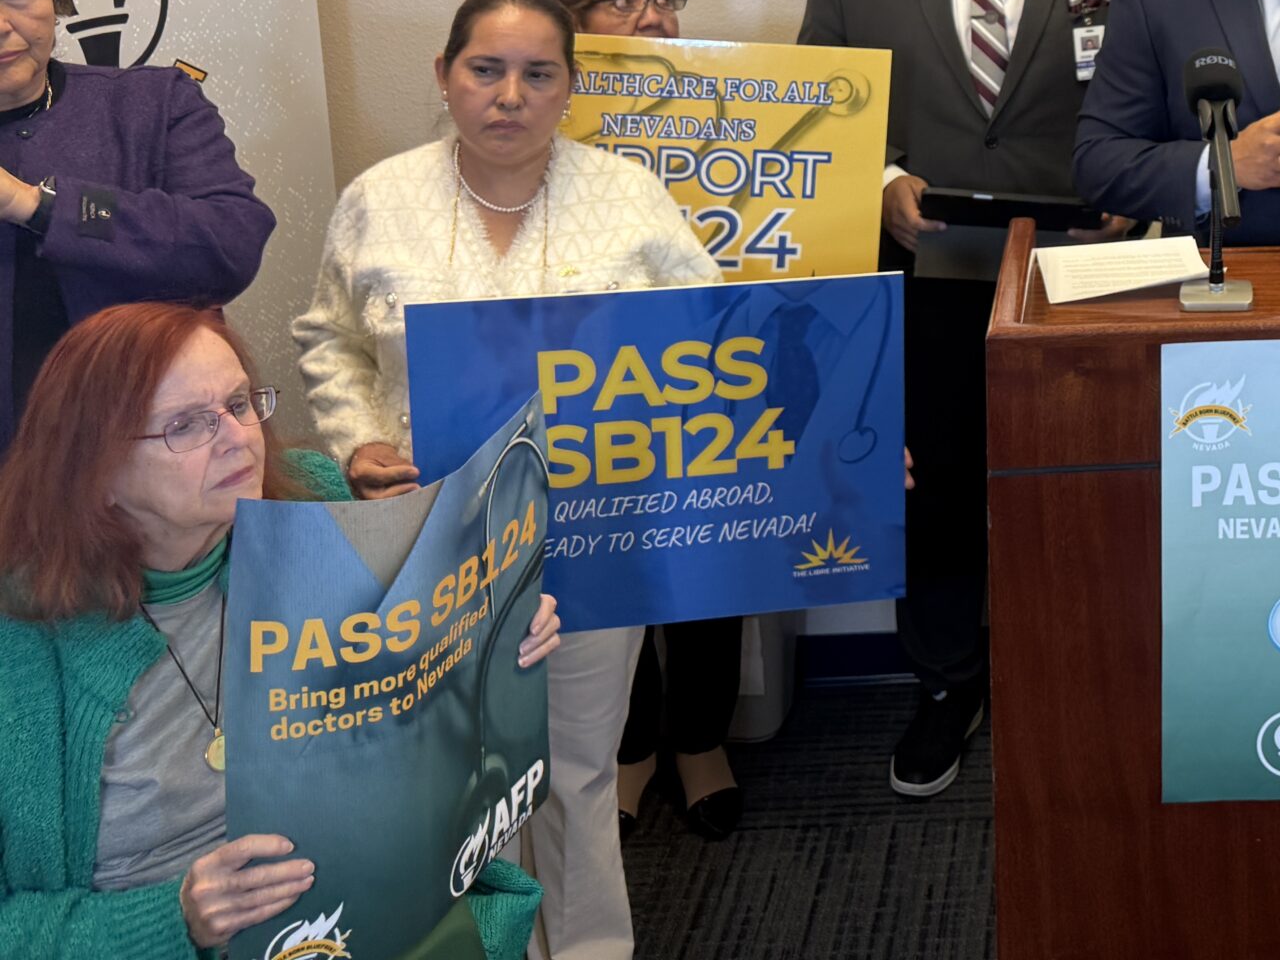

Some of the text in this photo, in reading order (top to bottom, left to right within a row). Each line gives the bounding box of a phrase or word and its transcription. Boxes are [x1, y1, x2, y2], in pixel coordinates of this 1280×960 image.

[571, 71, 835, 106] ALTHCARE FOR ALL
[601, 113, 756, 142] NEVADANS
[537, 336, 769, 415] PASS
[546, 407, 796, 489] SB124
[543, 512, 817, 558] EADY TO SERVE NEVADA!
[554, 482, 774, 523] QUALIFIED ABROAD,
[249, 500, 537, 673] PASS SB124
[269, 596, 489, 712] Bring more qualified
[271, 637, 472, 741] doctors to Nevada
[488, 804, 533, 863] NEVADA
[490, 759, 544, 847] AFP
